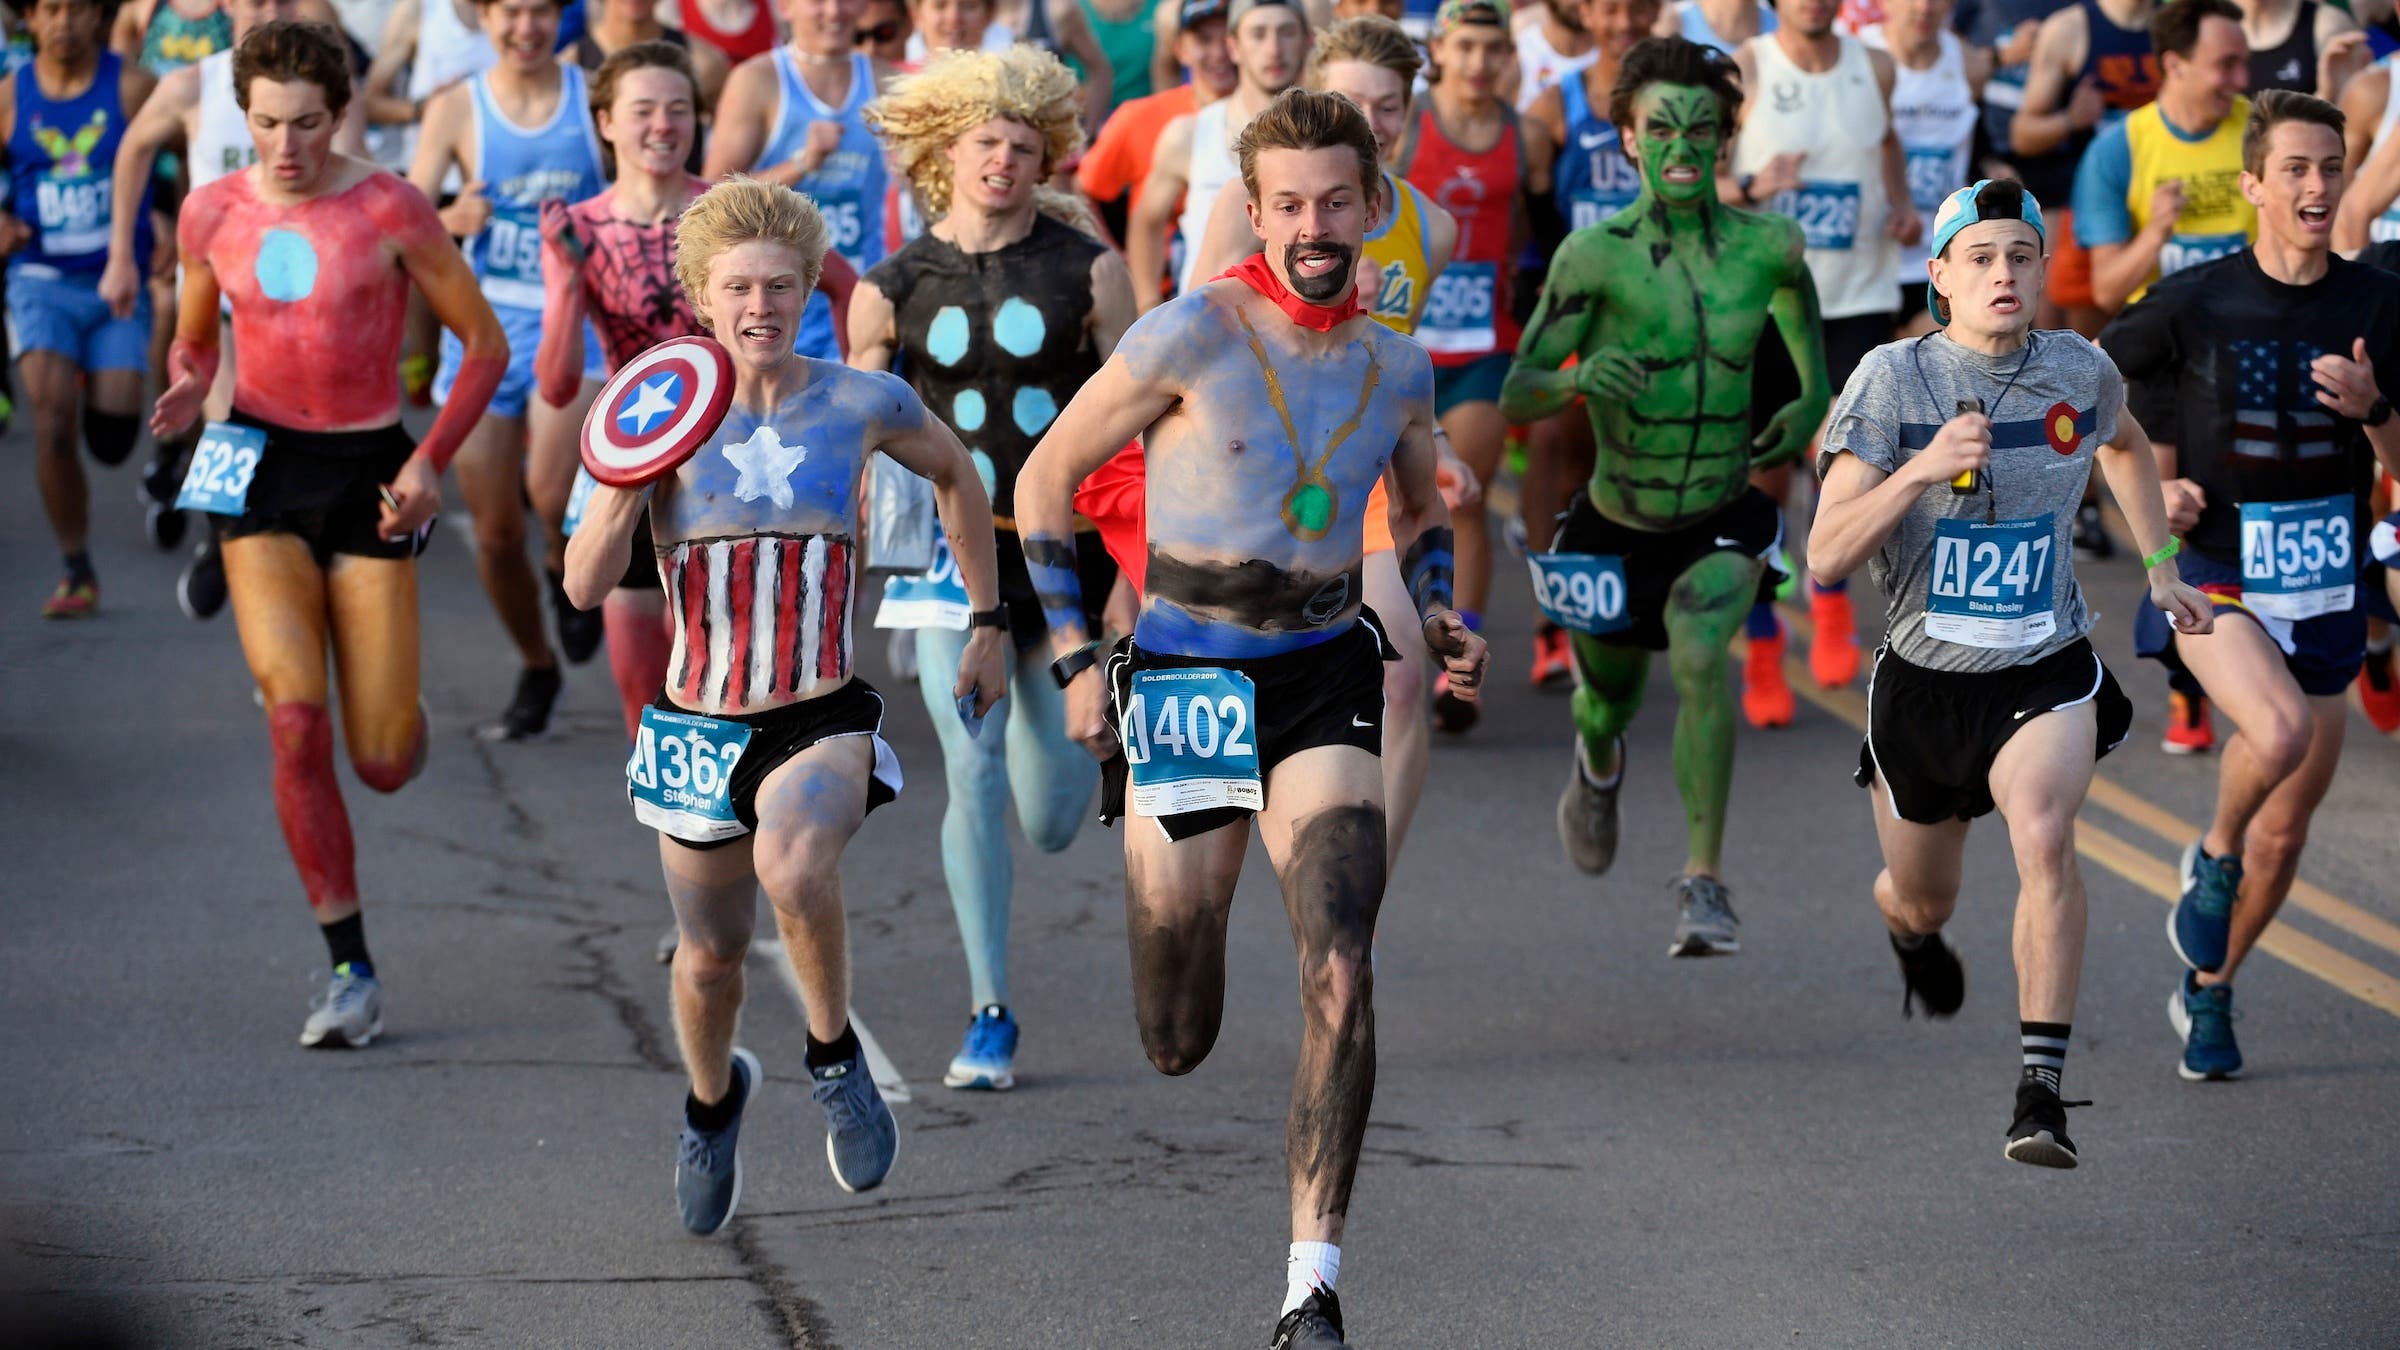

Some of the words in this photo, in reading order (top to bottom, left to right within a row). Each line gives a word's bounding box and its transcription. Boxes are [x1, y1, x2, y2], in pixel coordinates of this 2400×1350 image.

[1932, 535, 2051, 598] A247
[2243, 515, 2351, 579] A553
[1969, 601, 1994, 612] Blake
[1996, 602, 2024, 613] Bosley
[1121, 693, 1253, 764] A402
[663, 789, 711, 809] Stephen
